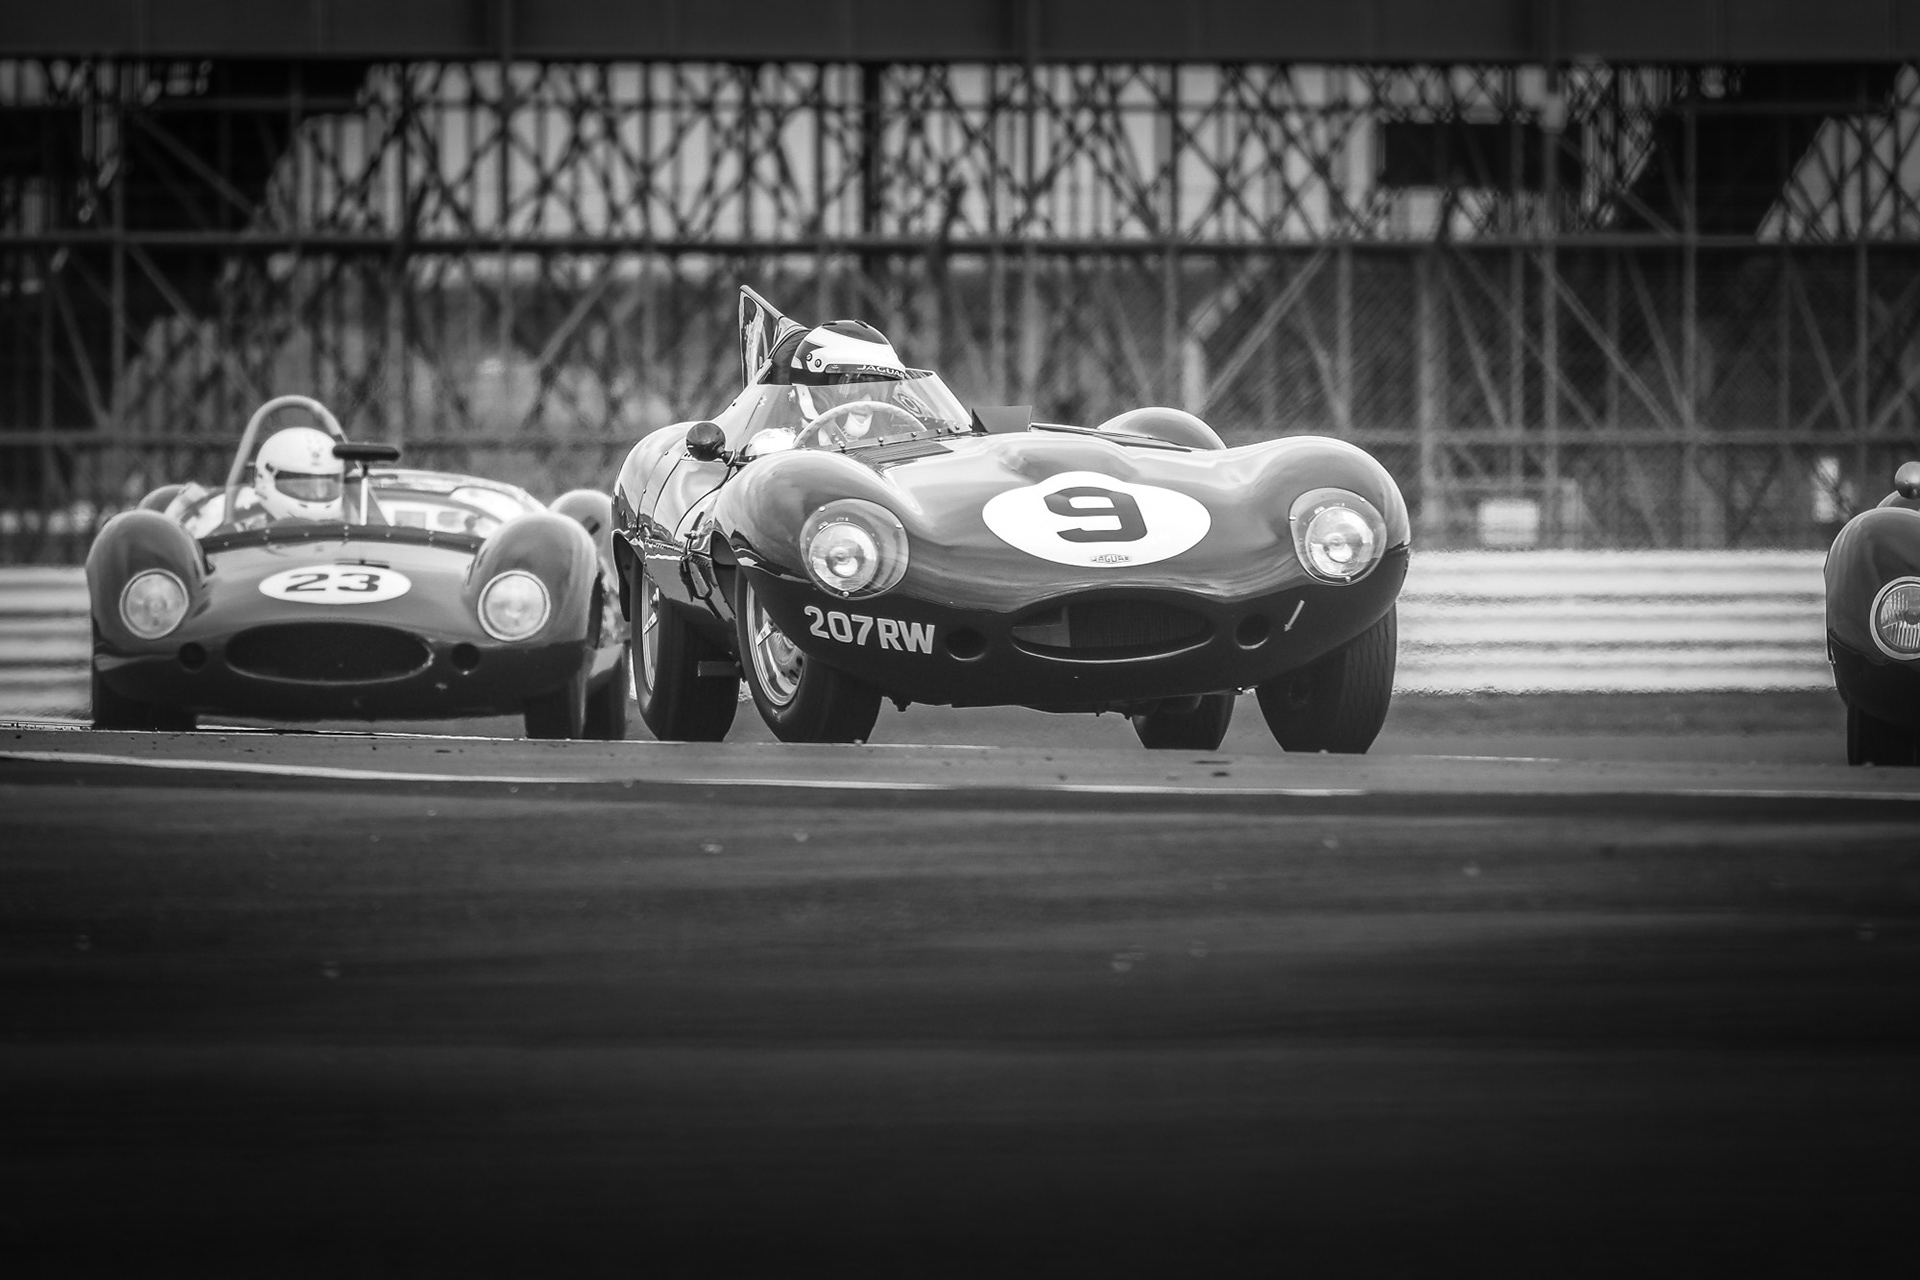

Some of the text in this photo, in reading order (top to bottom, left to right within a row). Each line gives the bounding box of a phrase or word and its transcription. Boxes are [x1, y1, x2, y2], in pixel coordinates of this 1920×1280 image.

[1043, 486, 1148, 543] 9
[285, 573, 380, 593] 23
[804, 605, 935, 654] 207RW
